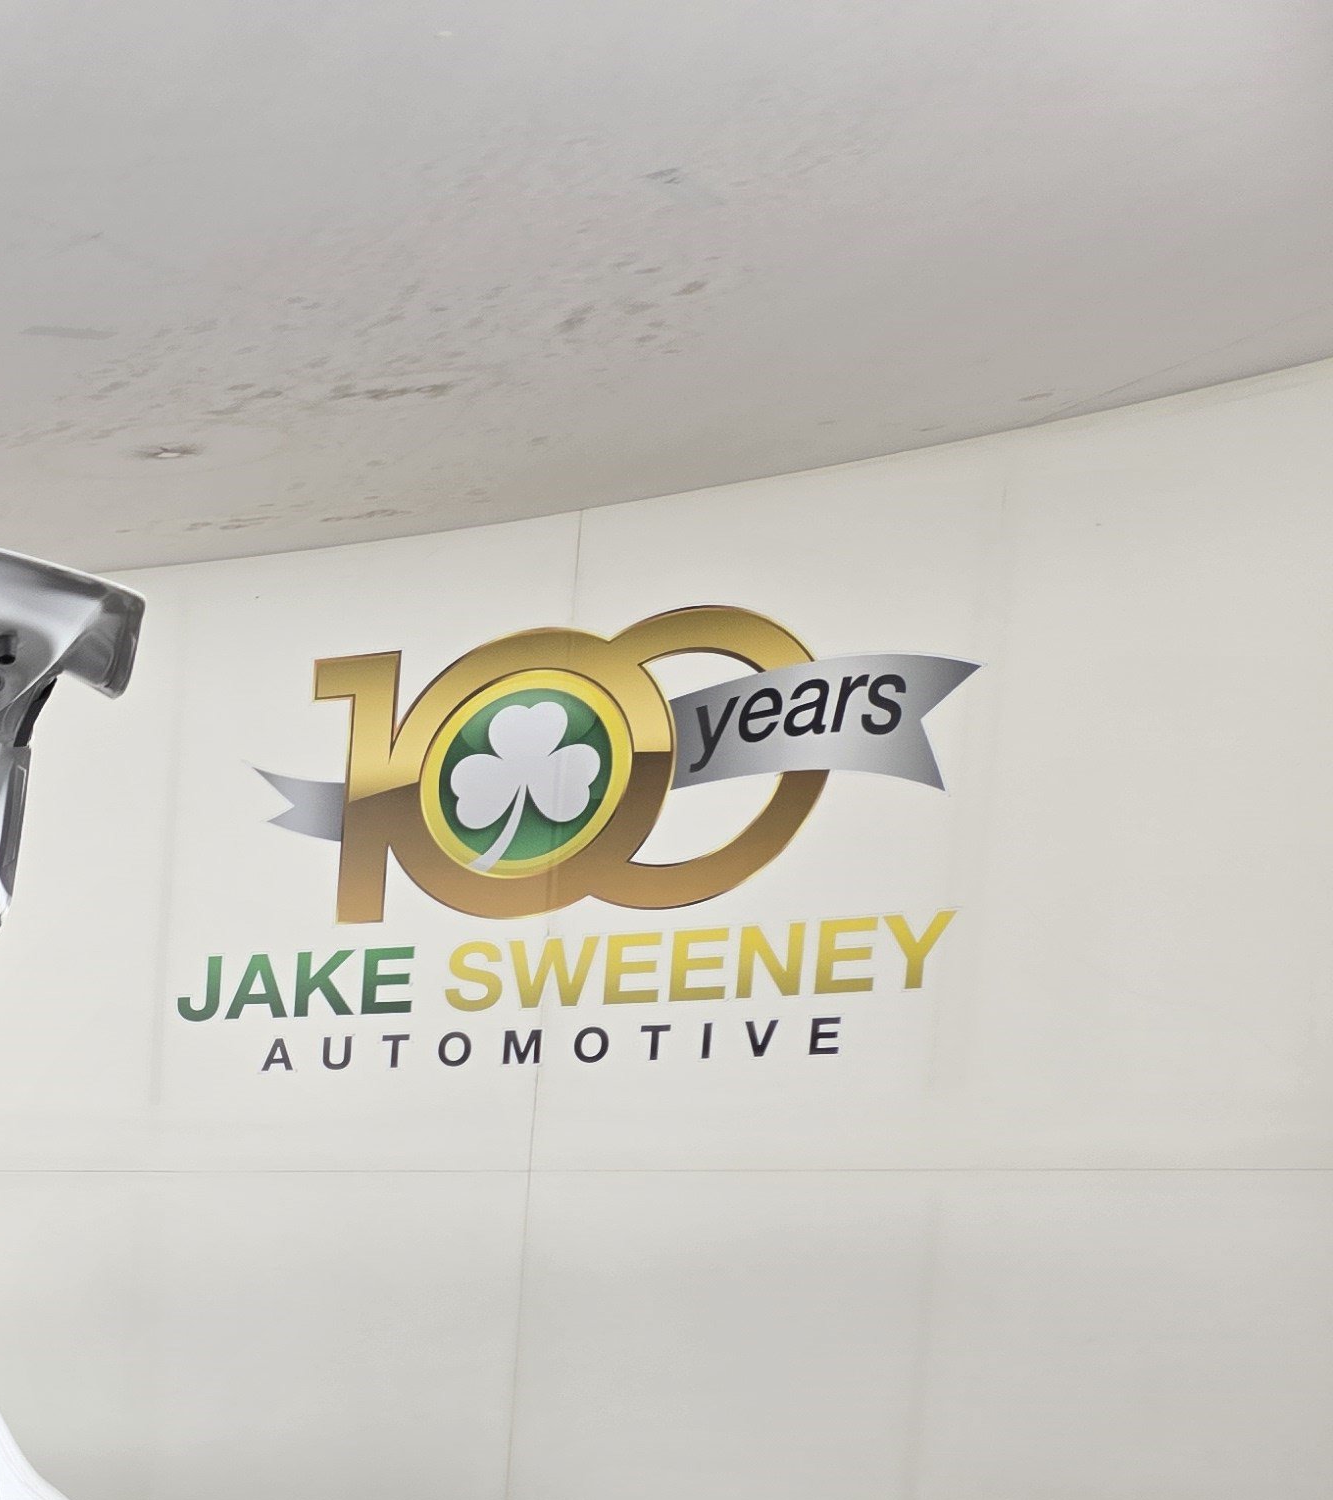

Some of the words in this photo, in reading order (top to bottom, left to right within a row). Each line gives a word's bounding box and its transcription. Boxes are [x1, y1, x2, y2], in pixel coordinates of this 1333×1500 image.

[313, 605, 830, 924] 100
[688, 671, 907, 773] years
[177, 945, 416, 1022] JAKE
[444, 908, 958, 1012] SWEENEY
[261, 1016, 841, 1071] AUTOMOTIVE
